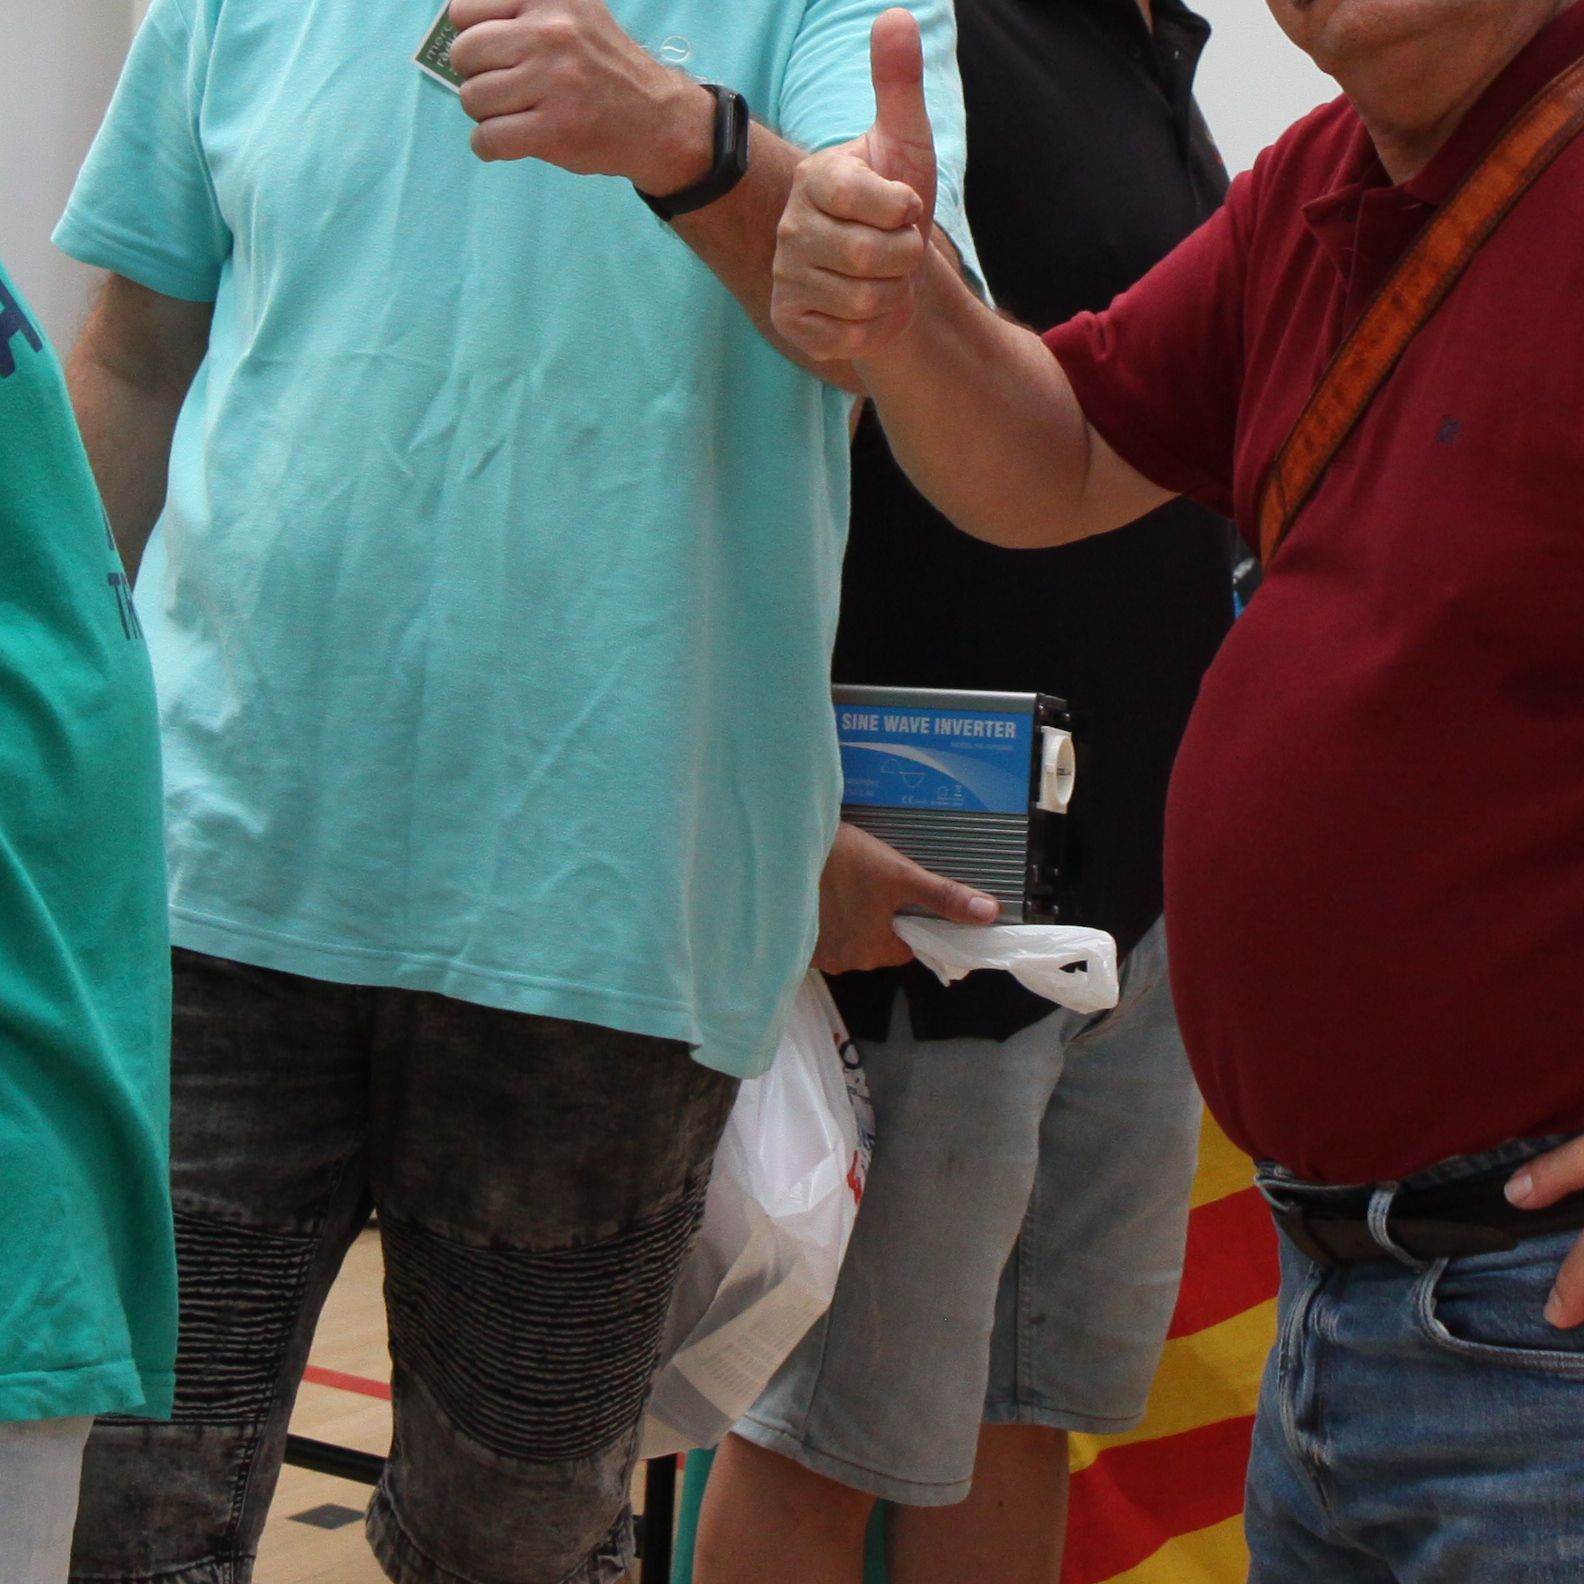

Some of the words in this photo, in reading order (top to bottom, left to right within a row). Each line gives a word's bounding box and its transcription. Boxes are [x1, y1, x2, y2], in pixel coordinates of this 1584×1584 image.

[842, 713, 879, 731] SINE
[884, 715, 930, 735] WAVE
[934, 718, 1017, 739] INVERTER
